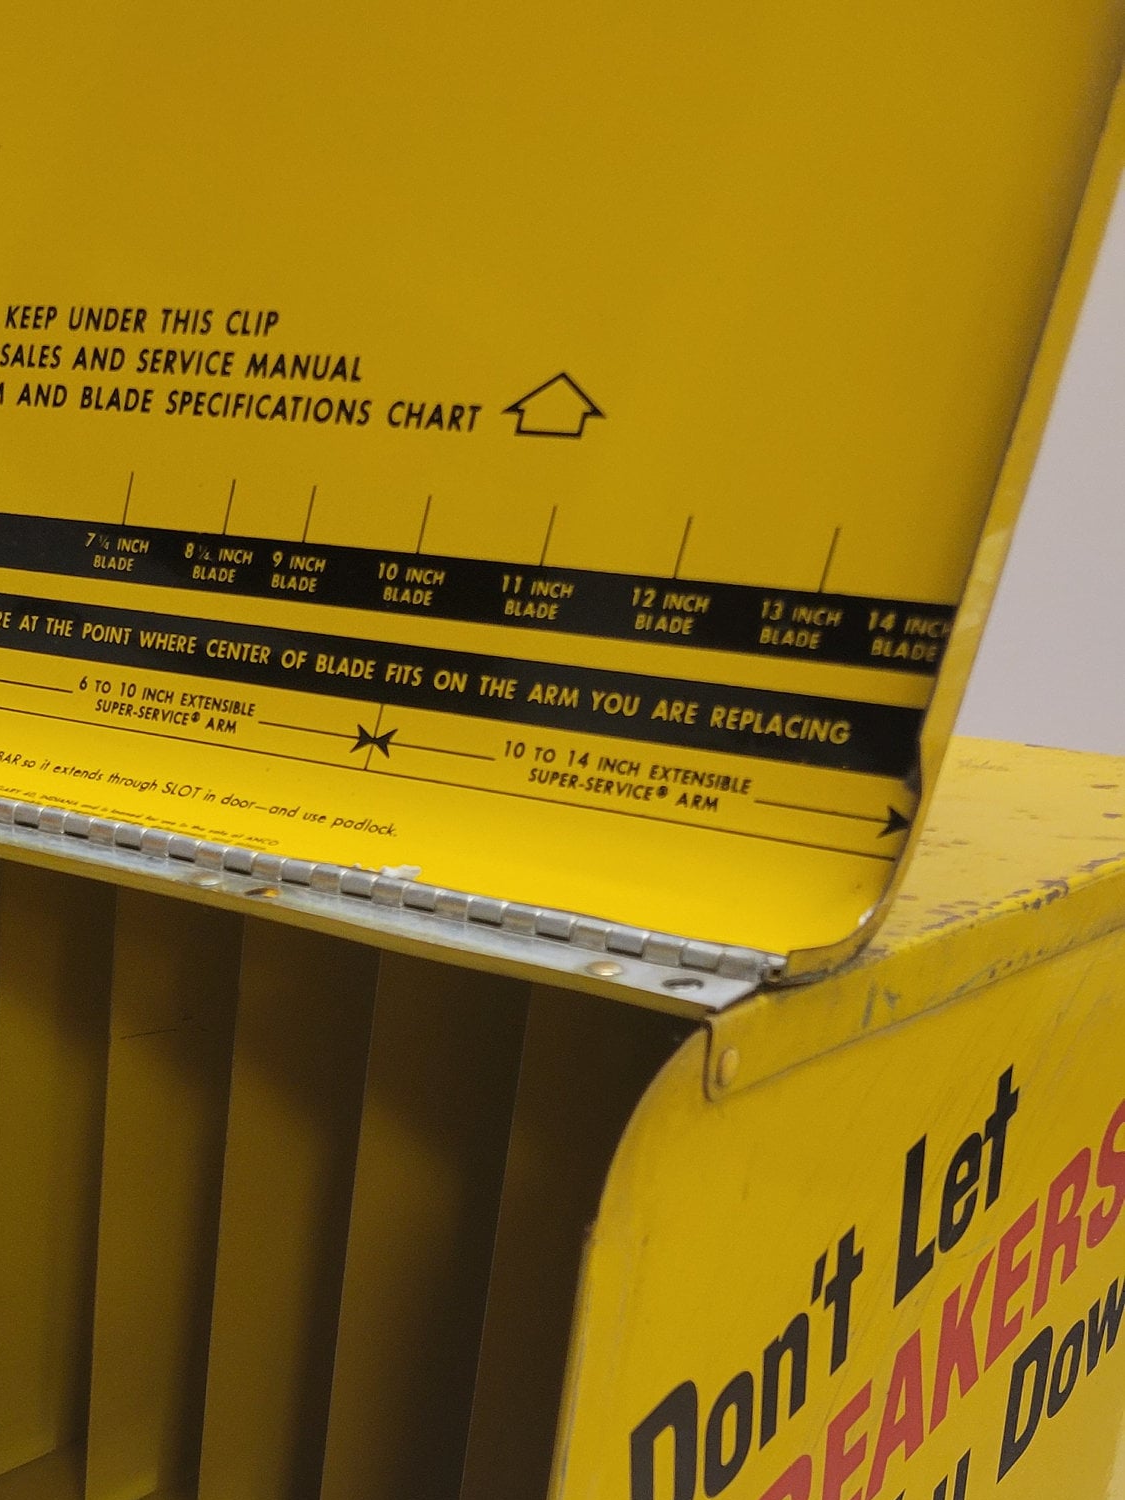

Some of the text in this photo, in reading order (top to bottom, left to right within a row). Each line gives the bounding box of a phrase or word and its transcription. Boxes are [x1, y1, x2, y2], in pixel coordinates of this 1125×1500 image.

[5, 305, 280, 338] KEEP UNDER THIS CLIP
[73, 345, 125, 372] AND
[137, 348, 233, 376] SERVICE
[245, 351, 363, 383] MANUAL
[16, 383, 68, 408] AND
[80, 385, 153, 414] BLADE
[164, 390, 371, 427] SPECIFICATIONS
[386, 400, 482, 433] CHART
[117, 537, 149, 555] INCH
[218, 547, 253, 566] INCH
[93, 555, 133, 572] BLADE
[273, 551, 326, 573] 9 INCH
[192, 565, 236, 583] BLADE
[271, 573, 318, 593] BLADE
[378, 562, 445, 586] 10 INCH
[383, 587, 433, 606] BLADE
[501, 575, 574, 599] 11 INCH
[504, 600, 559, 620] BLADE
[632, 587, 710, 613] 12 INCH
[634, 614, 693, 636] BLADE
[760, 601, 843, 628] 13 INCH
[868, 611, 892, 631] 14
[759, 628, 822, 651] BLADE
[870, 639, 938, 663] BLADE
[19, 615, 39, 632] AT
[45, 618, 74, 638] THE
[81, 623, 132, 646] POINT
[139, 631, 197, 655] WHERE
[206, 640, 270, 664] CENTER
[281, 650, 307, 669] OF
[315, 655, 374, 679] BLADE
[384, 664, 423, 687] FITS
[433, 670, 468, 693] ON
[480, 676, 516, 699] THE
[527, 683, 579, 708] ARM
[591, 690, 640, 717] YOU
[651, 699, 698, 725] ARE
[710, 706, 851, 745] REPLACING
[79, 676, 255, 717] 6 TO 10 INCH EXTENSIBLE
[205, 717, 237, 734] ARM
[504, 741, 754, 795] 10 TO 14 INCH EXTENSIBLE
[21, 758, 36, 768] so
[40, 759, 50, 771] it
[52, 763, 103, 782] extends
[108, 772, 157, 793] through
[162, 781, 203, 799] SLOT
[204, 789, 216, 802] in
[303, 812, 326, 825] use
[331, 816, 397, 838] padlock.
[675, 793, 719, 812] ARM
[893, 1063, 1019, 1309] Let
